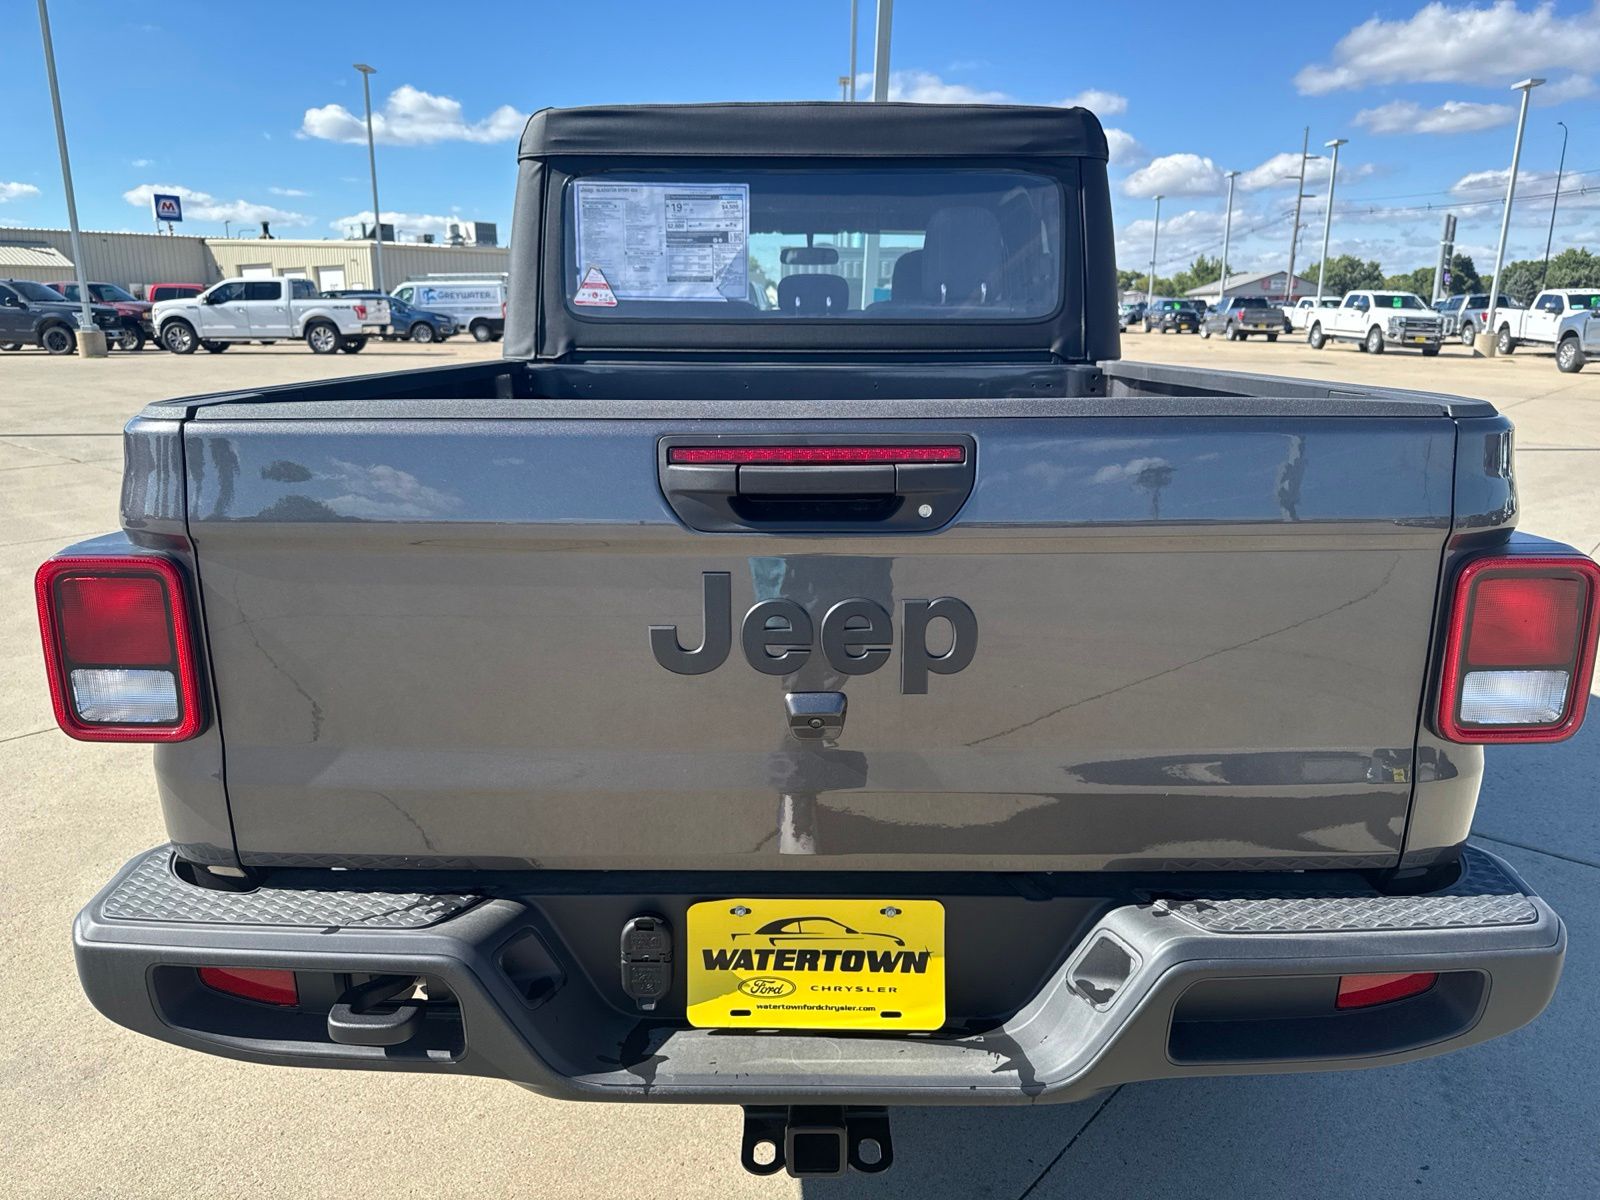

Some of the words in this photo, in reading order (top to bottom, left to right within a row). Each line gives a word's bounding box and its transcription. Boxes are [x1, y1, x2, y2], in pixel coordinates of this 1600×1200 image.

[671, 203, 683, 212] 19
[437, 290, 491, 300] GREYWATER
[648, 571, 978, 694] Jeep
[702, 948, 930, 974] WATERTOWN
[750, 979, 785, 995] Ford
[810, 985, 898, 993] CHRYSLER
[756, 1003, 876, 1012] watertownfordchrysler.com
